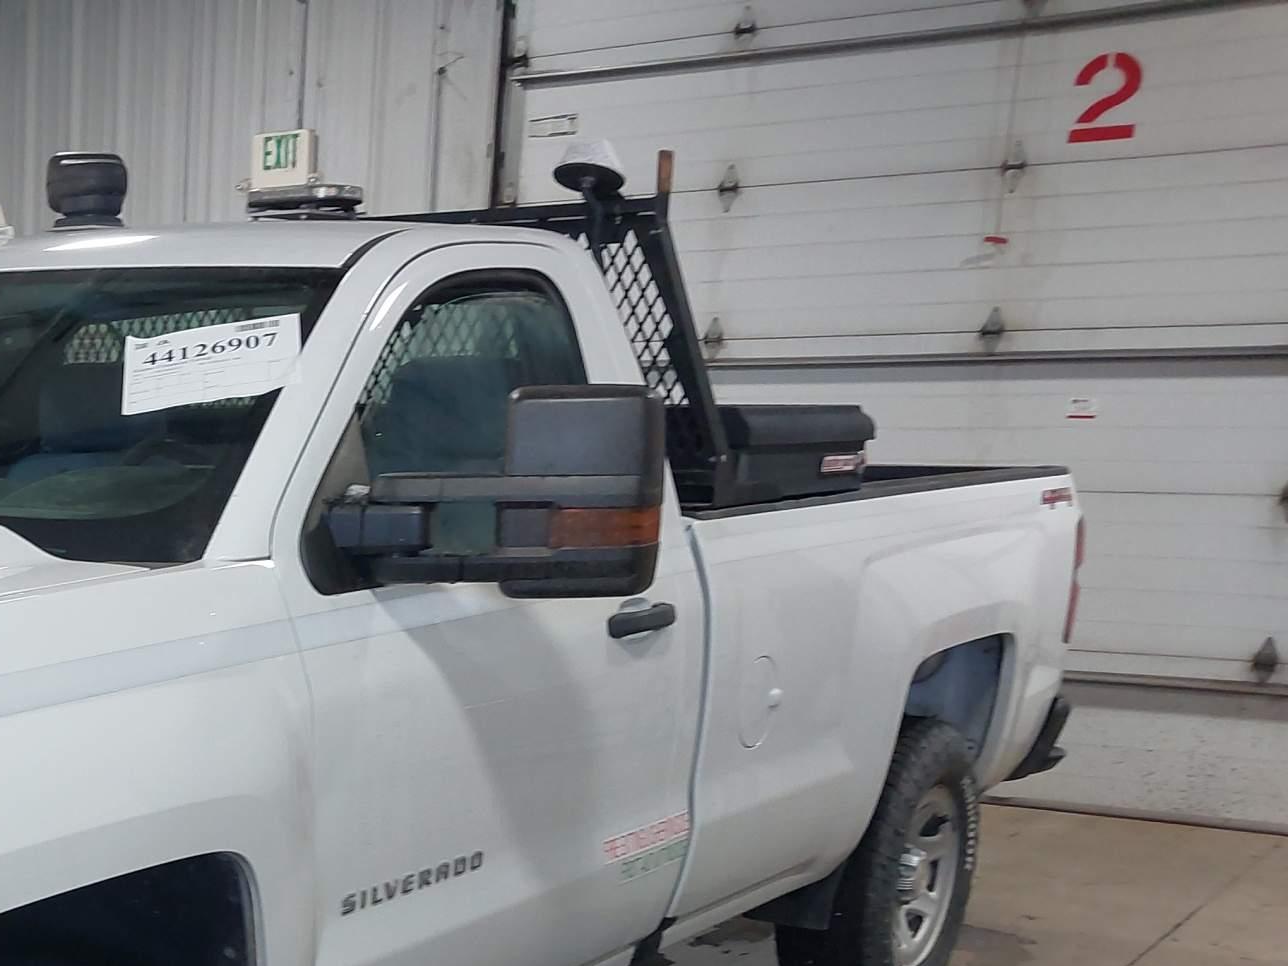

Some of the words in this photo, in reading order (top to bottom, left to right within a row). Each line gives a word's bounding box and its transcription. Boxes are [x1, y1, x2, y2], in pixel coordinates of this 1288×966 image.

[1067, 51, 1143, 144] 2
[262, 132, 300, 171] EXIT
[142, 332, 279, 367] 44126907
[340, 850, 484, 917] SILVERADO
